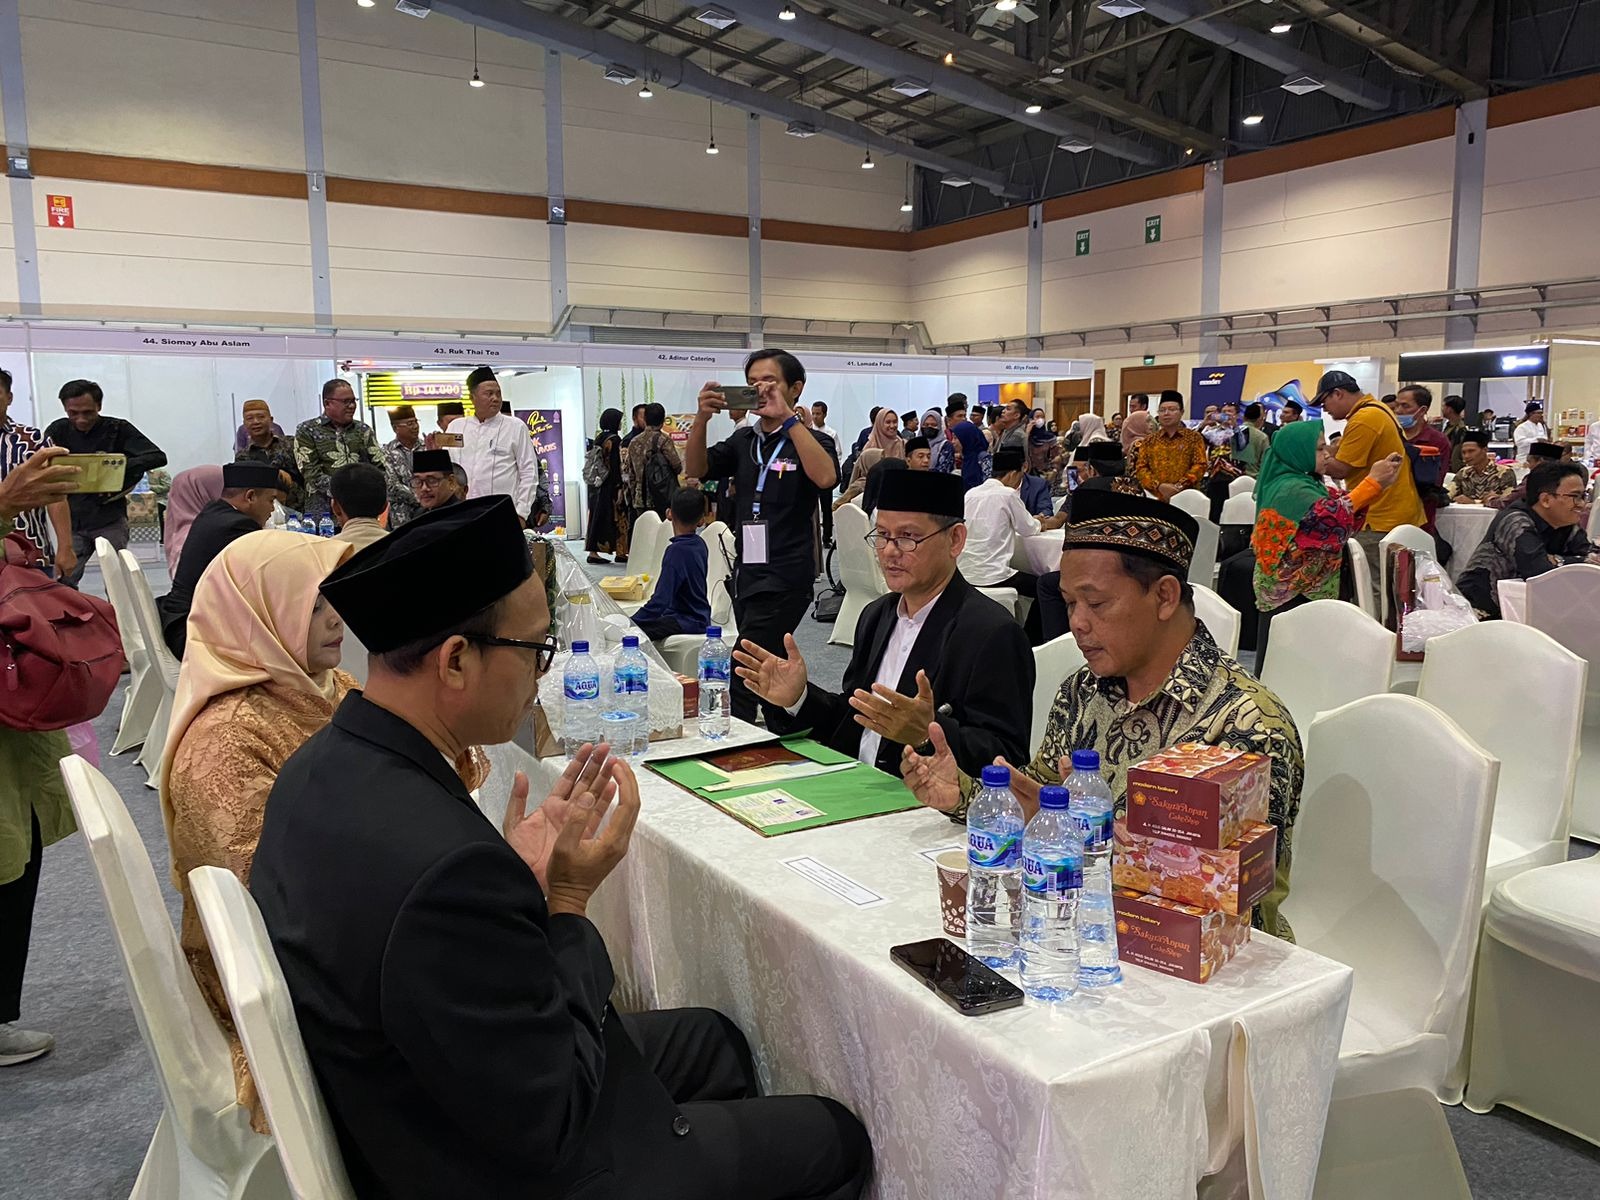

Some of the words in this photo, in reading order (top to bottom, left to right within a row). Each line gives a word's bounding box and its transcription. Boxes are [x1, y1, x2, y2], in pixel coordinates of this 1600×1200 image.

[51, 206, 70, 214] FIRE
[1147, 218, 1160, 227] EXIT
[1077, 232, 1089, 240] EXIT
[161, 338, 197, 347] Siomay
[690, 355, 716, 363] Catering
[403, 385, 419, 396] Rp
[575, 680, 597, 691] AQUA
[1132, 781, 1157, 789] modern
[1157, 785, 1179, 794] bakery
[969, 833, 994, 851] QUA
[1116, 910, 1140, 920] modern
[1140, 915, 1161, 926] bakery
